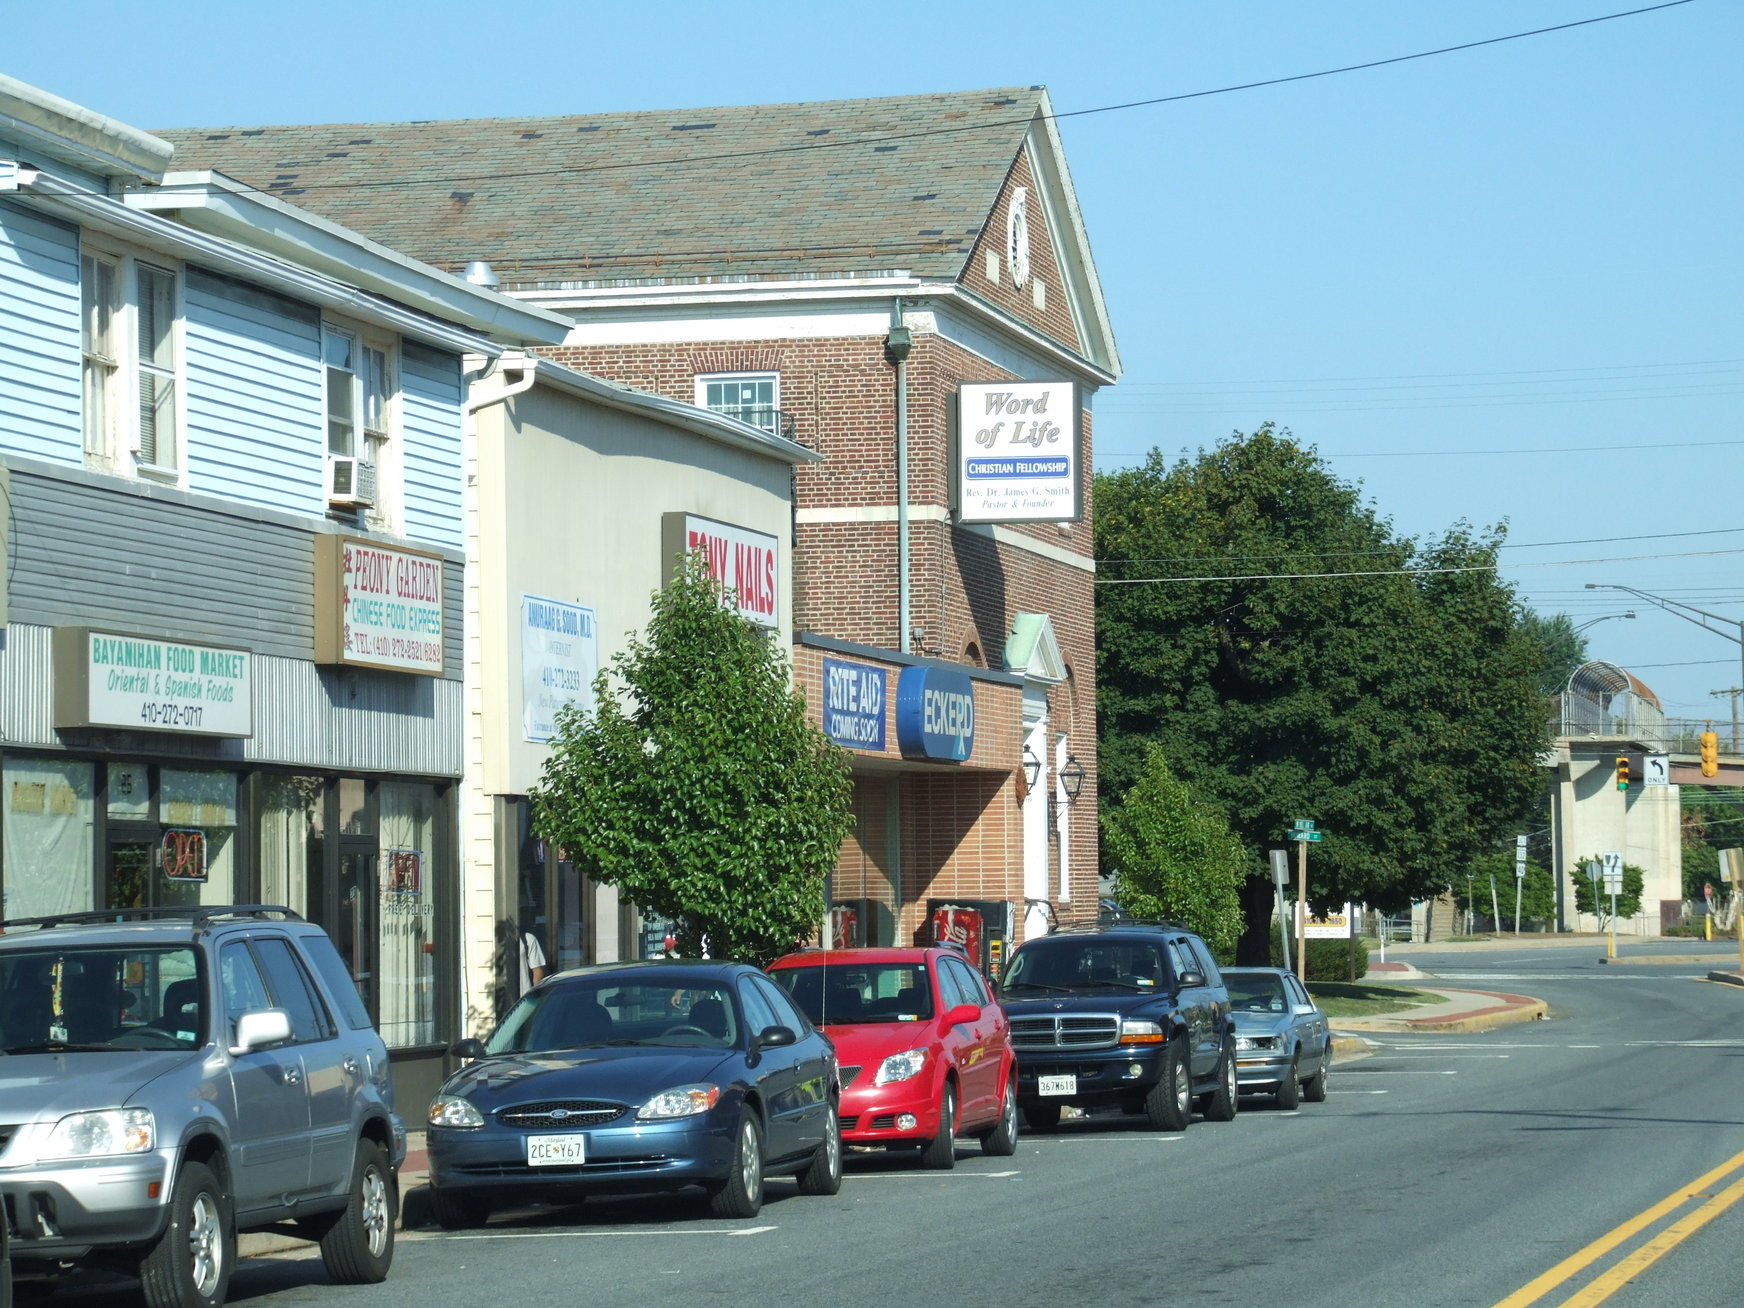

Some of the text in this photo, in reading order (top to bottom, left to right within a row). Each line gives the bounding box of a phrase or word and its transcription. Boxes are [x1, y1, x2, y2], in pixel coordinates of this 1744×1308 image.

[985, 391, 1050, 416] Word
[975, 420, 1060, 449] of Life
[968, 462, 1067, 474] CHRISTIAN FELLOWSHIP
[982, 499, 1055, 509] Pastor & Founder
[987, 487, 1000, 497] Dr.
[1003, 487, 1029, 496] James
[1045, 486, 1070, 496] Smith
[353, 549, 439, 603] PEONY GARDEN
[735, 542, 774, 616] NAILS
[352, 597, 440, 635] CHINESE FOOD EXPRESS
[93, 637, 245, 679] BAYANIHAN FOOD MARKET
[373, 635, 390, 657] (410)
[107, 669, 234, 703] Oriental & Spanish Foods
[829, 666, 881, 715] RITE AID
[141, 702, 203, 727] 410-272-0717
[831, 713, 879, 743] COMING SOON
[924, 689, 973, 746] ECKERD
[164, 831, 206, 877] OPEN
[531, 1143, 581, 1158] 2CE Y67
